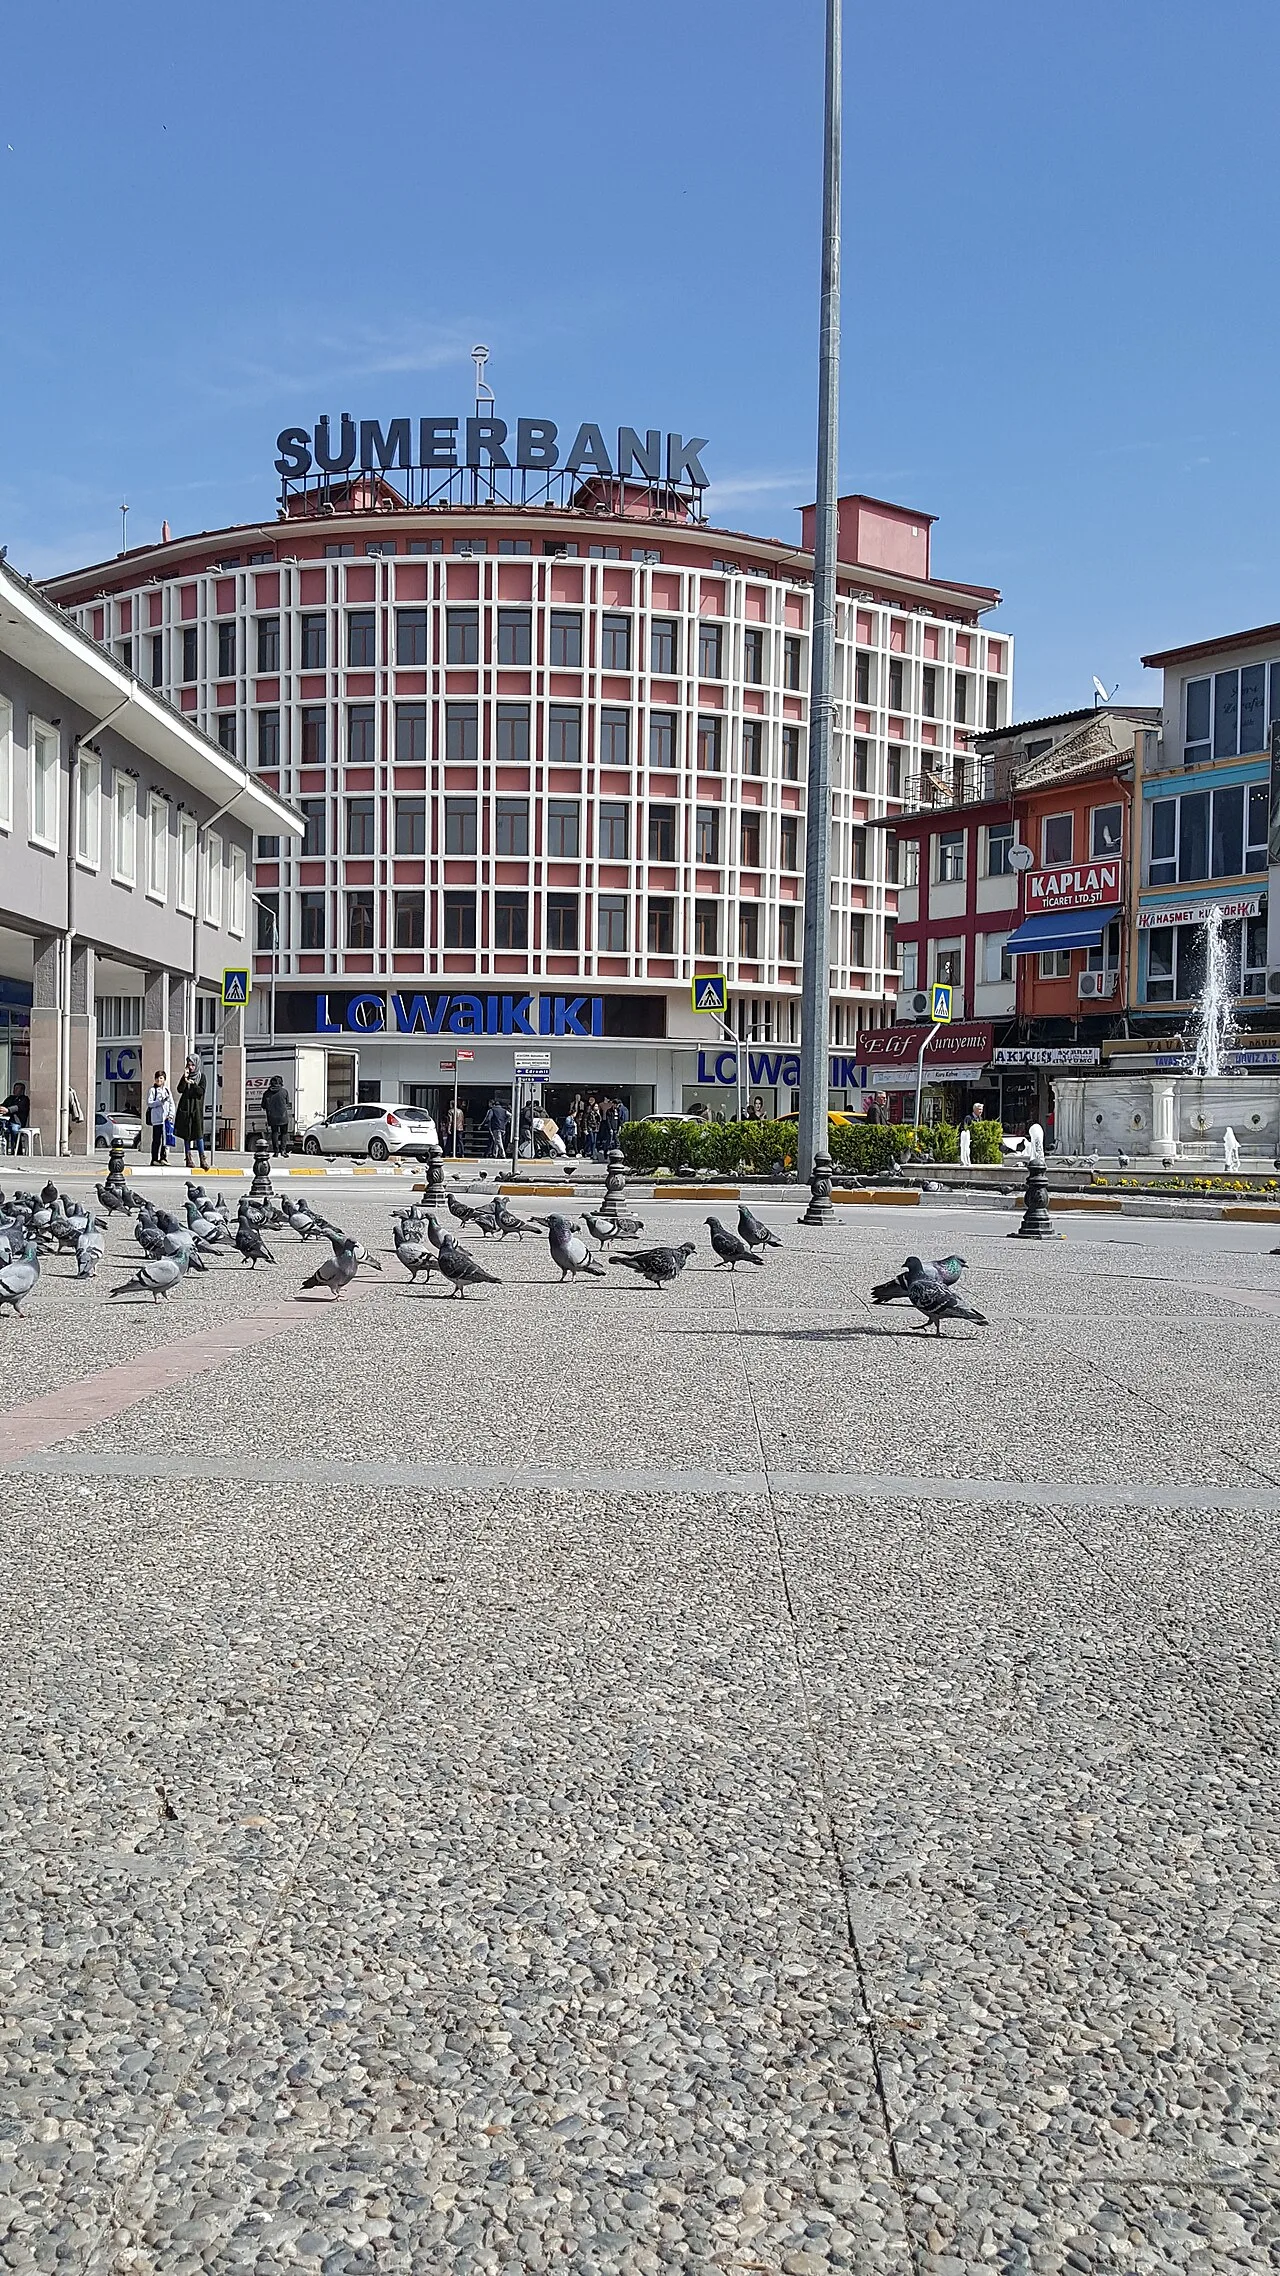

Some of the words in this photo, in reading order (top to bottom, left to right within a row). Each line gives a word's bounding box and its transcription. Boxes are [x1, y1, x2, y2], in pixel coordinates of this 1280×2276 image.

[274, 412, 710, 488] SÜMERBANK
[1031, 866, 1116, 898] KAPLAN
[1042, 895, 1073, 908] TİCARET
[1156, 911, 1194, 924] HAŞMET
[859, 1033, 918, 1058] Elif
